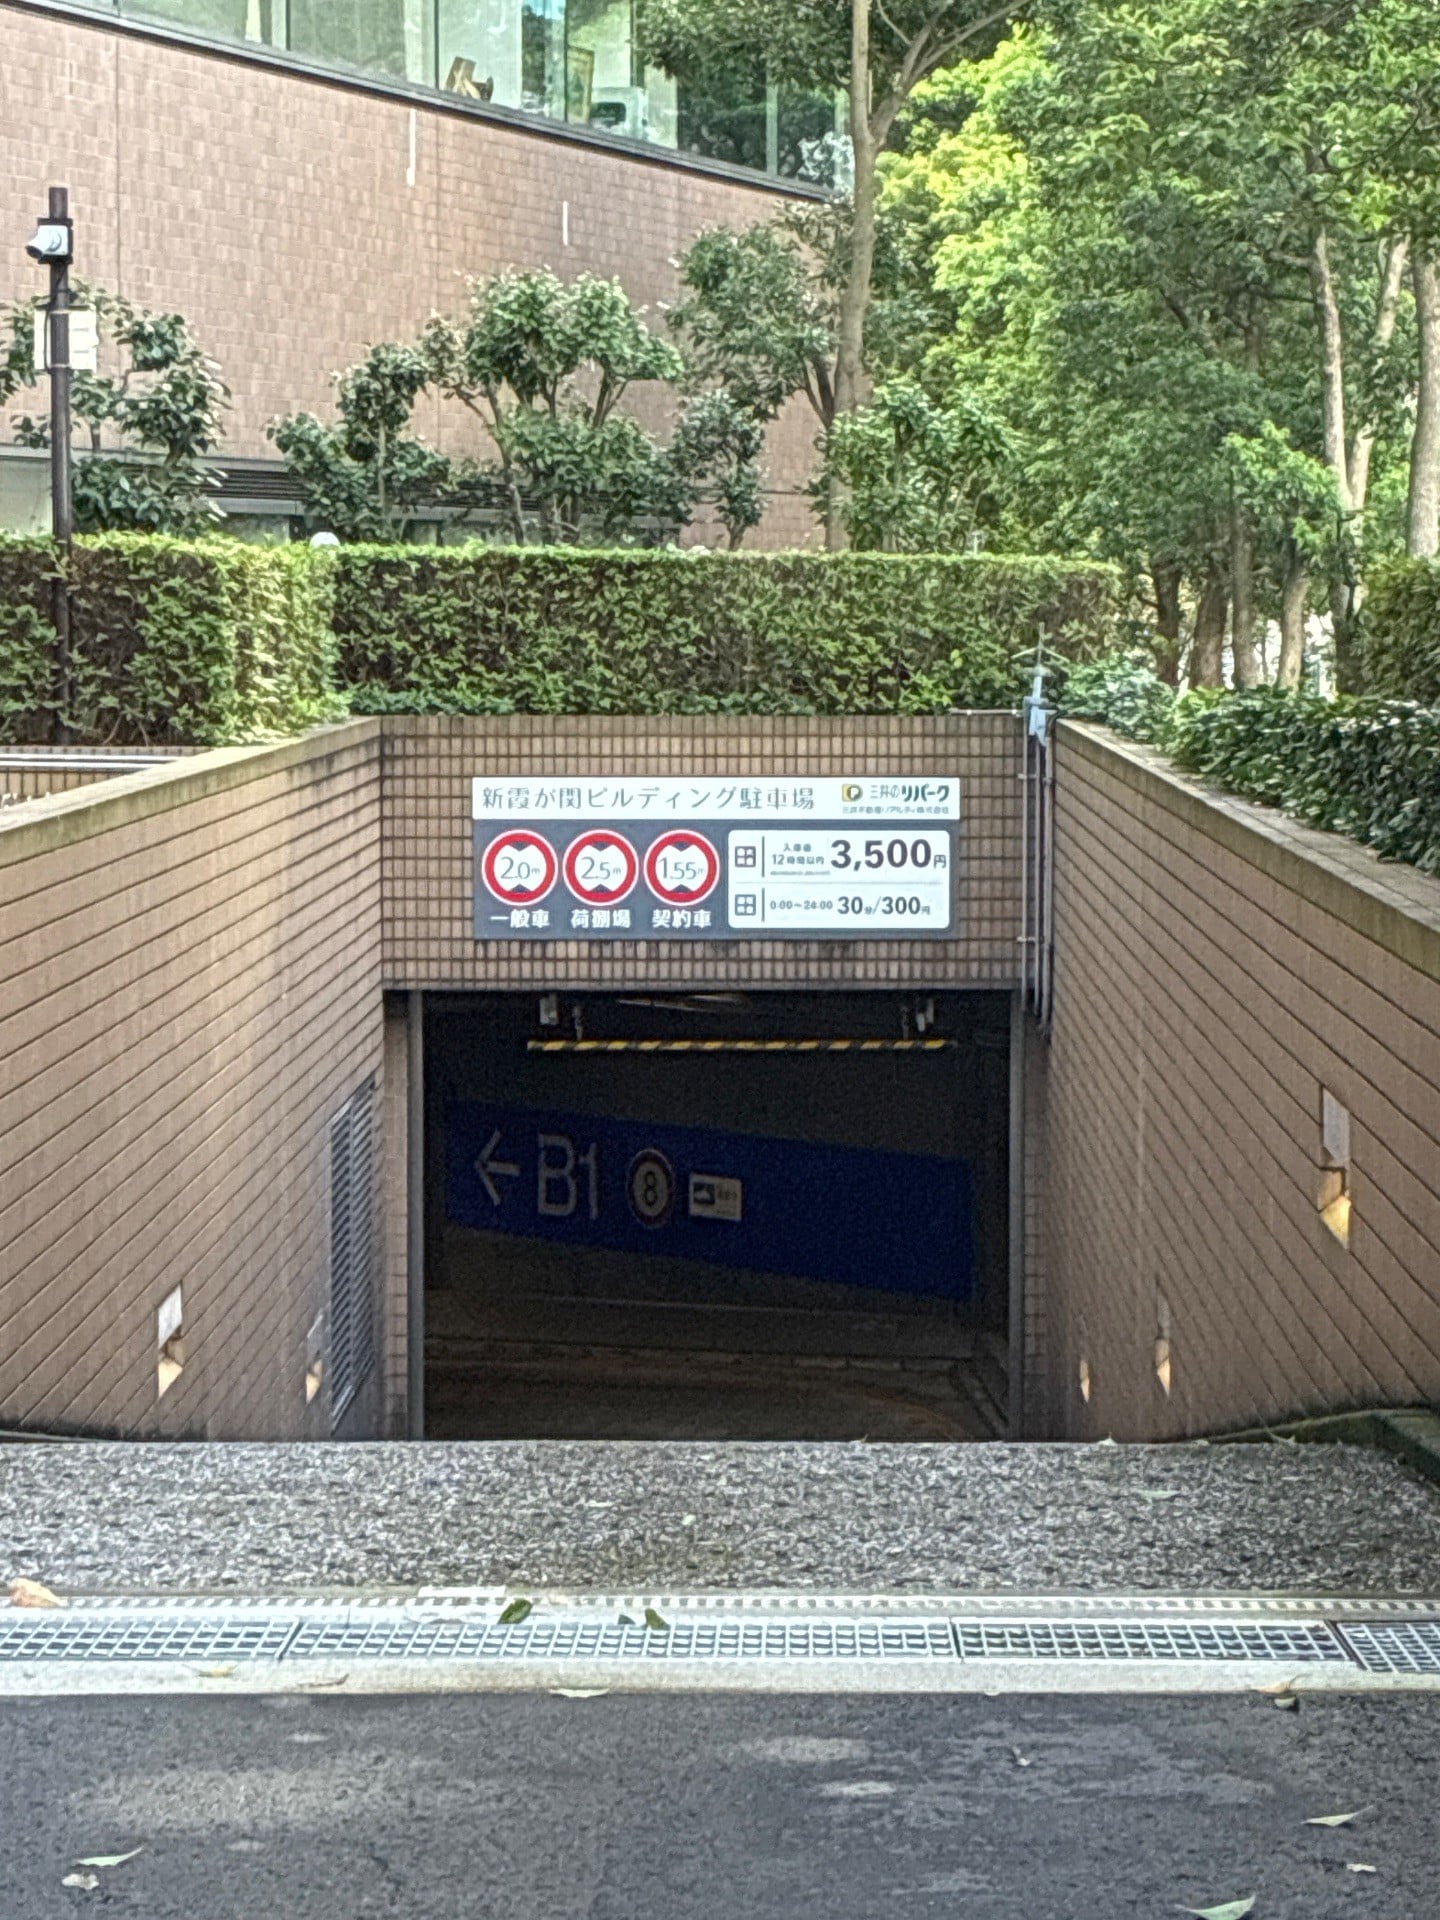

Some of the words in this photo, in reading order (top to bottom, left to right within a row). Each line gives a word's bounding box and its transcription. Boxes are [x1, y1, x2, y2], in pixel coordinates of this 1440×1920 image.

[483, 786, 814, 810] 新霞が関ビルディング駐車場
[869, 783, 950, 803] 三井のリパーク
[490, 908, 550, 929] 一般車
[652, 908, 713, 929] 契約車
[536, 1132, 599, 1221] B1
[643, 1170, 659, 1208] 8
